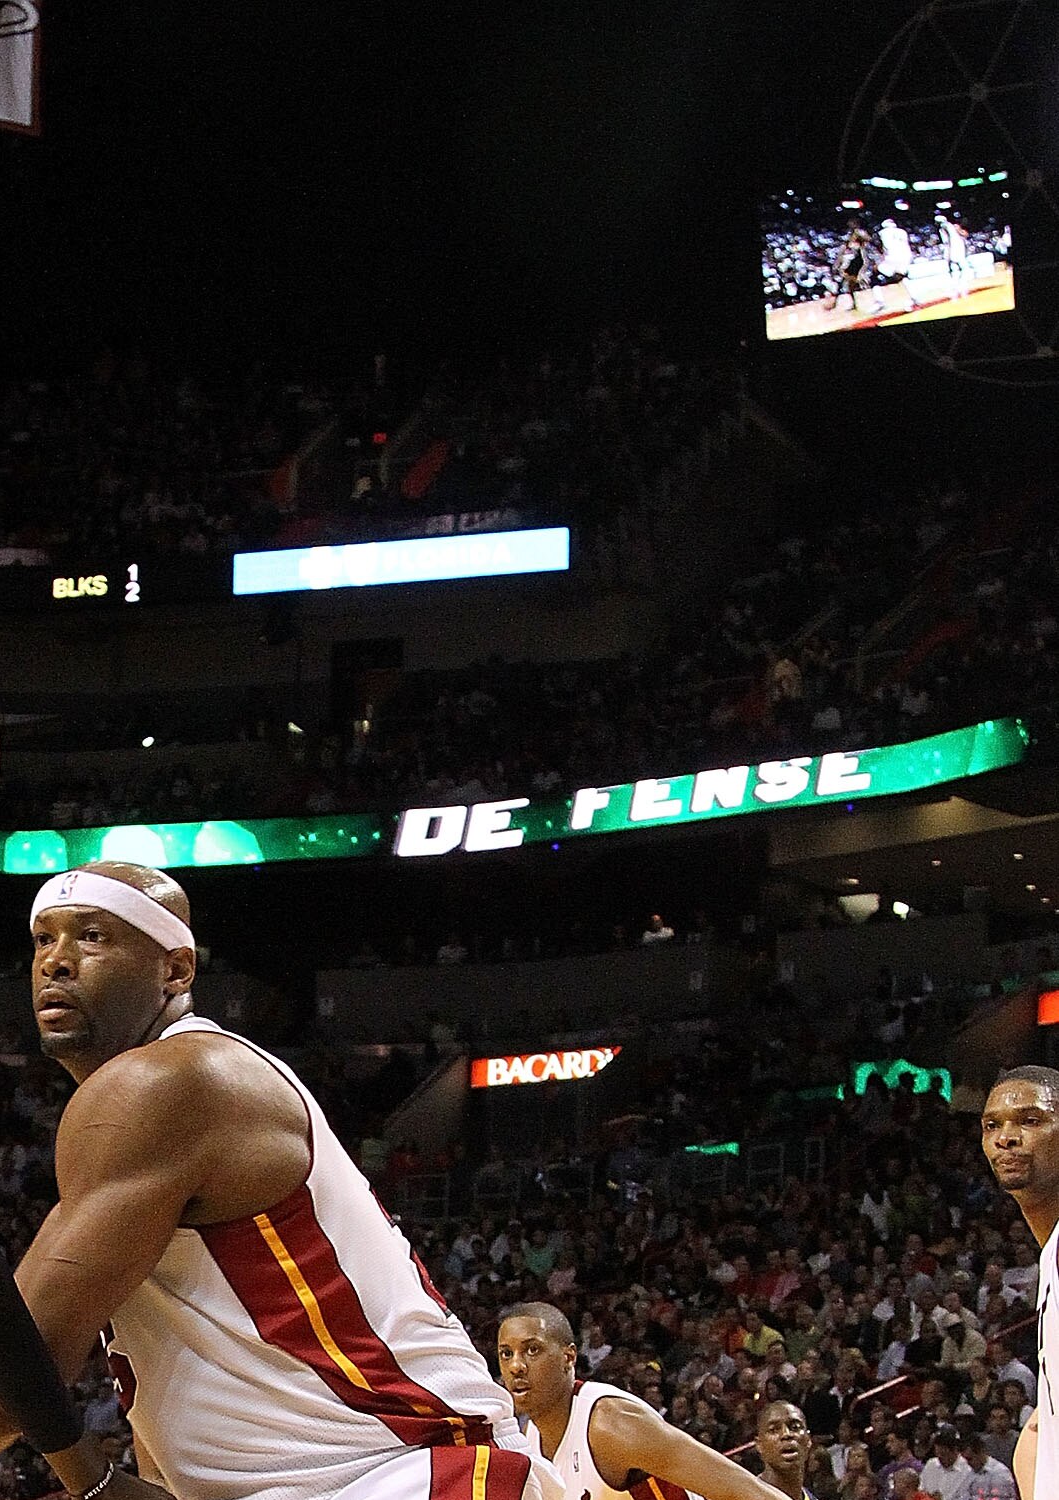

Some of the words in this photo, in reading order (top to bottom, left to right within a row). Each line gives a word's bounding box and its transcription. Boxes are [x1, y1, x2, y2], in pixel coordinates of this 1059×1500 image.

[52, 574, 109, 599] BLKS
[127, 563, 139, 582] 1
[124, 581, 141, 604] 2
[396, 797, 531, 858] DE
[570, 751, 872, 831] FENSE
